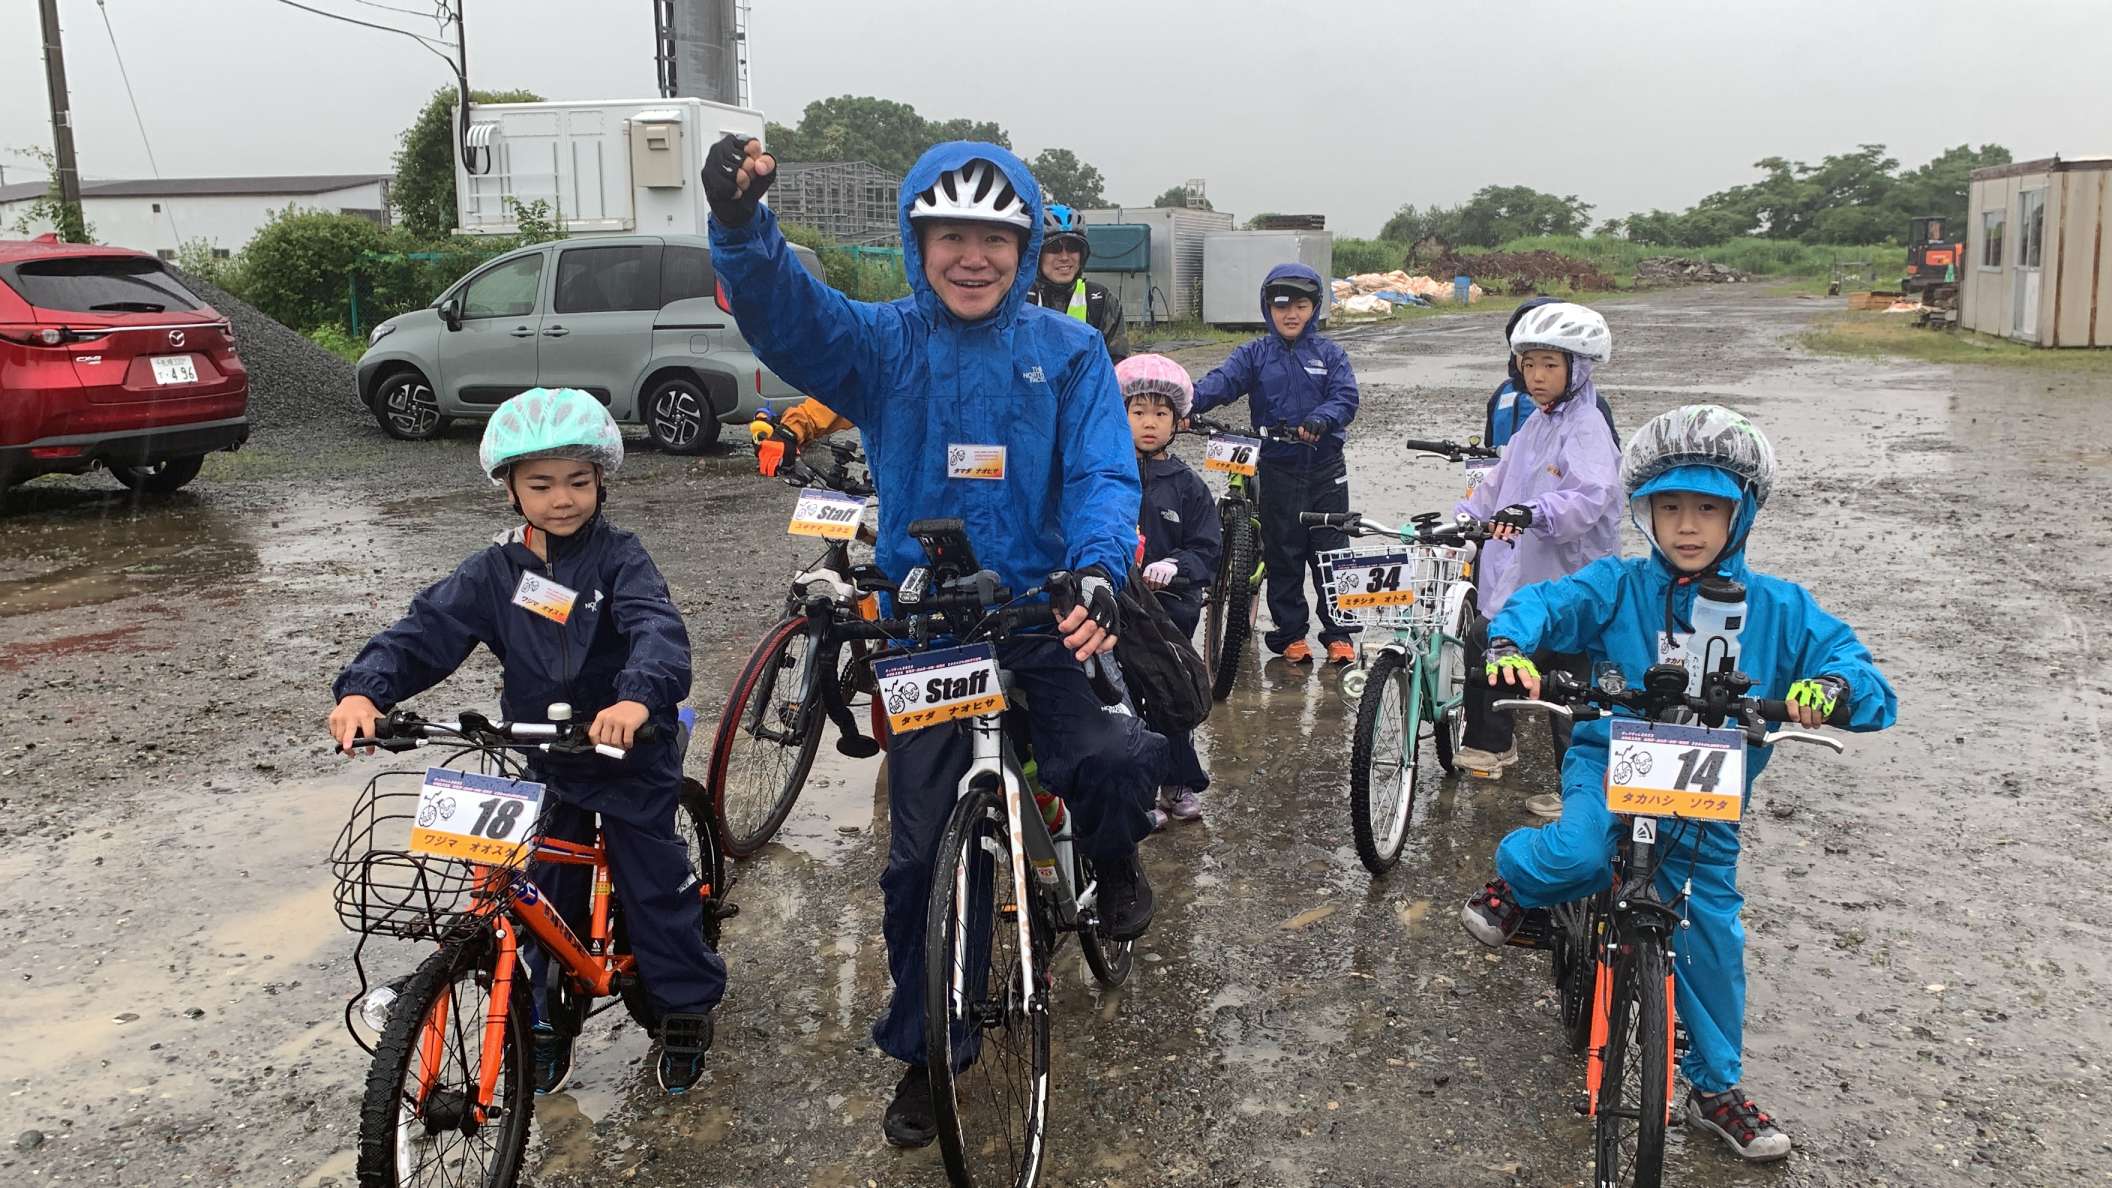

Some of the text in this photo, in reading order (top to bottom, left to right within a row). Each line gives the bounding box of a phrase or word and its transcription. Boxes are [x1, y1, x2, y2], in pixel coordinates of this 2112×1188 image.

[1230, 446, 1253, 464] 16
[817, 506, 859, 522] Staff
[1367, 566, 1402, 593] 34
[925, 669, 989, 704] Staff
[901, 699, 995, 726] タマダ ナオヒサ
[1673, 748, 1727, 793] 14
[1622, 793, 1728, 811] タカハシ ソウタ
[470, 798, 524, 840] 18
[424, 834, 458, 848] ワジマ
